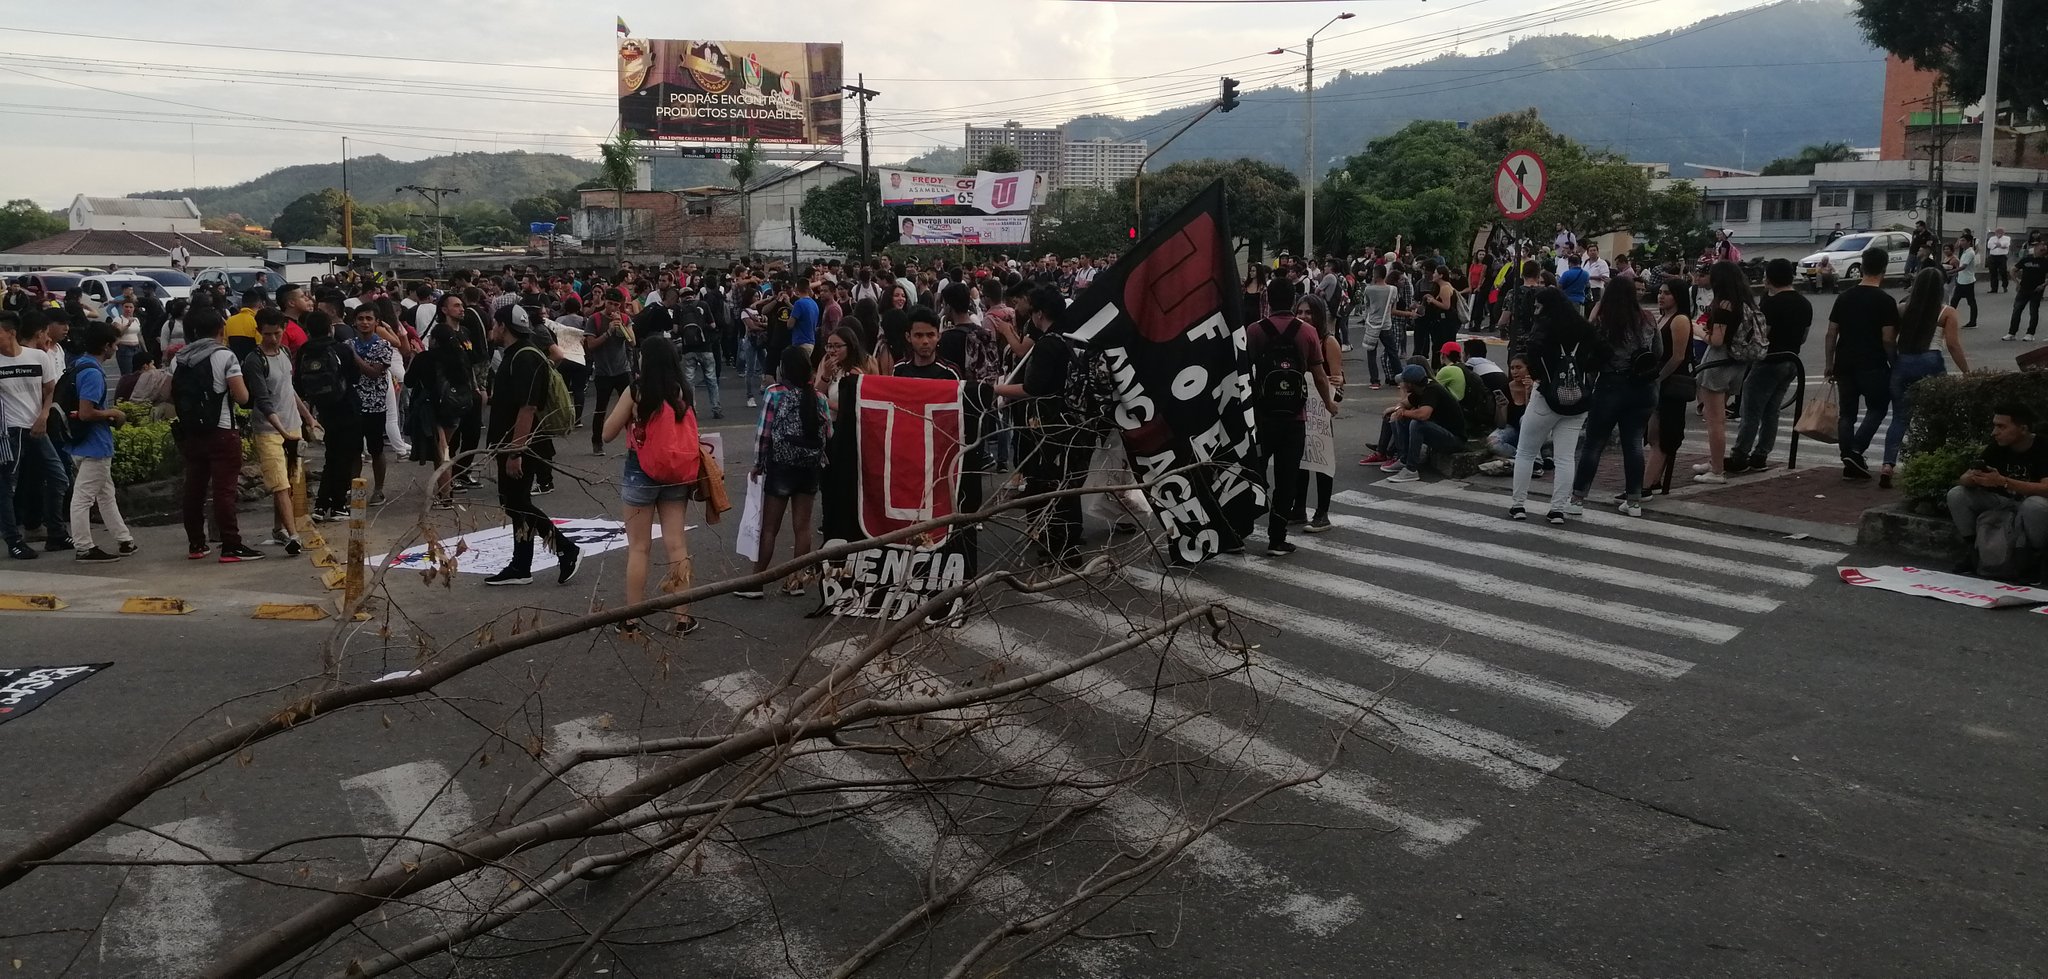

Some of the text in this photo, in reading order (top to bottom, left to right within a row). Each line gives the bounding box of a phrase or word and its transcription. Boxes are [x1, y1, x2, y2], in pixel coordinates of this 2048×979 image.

[670, 92, 718, 104] PODRÁS
[721, 94, 791, 106] ENCONTRAR
[656, 106, 727, 118] PRODUCTOS
[912, 176, 943, 184] FREDY
[958, 192, 973, 204] 65
[822, 538, 965, 591] CIENCIA
